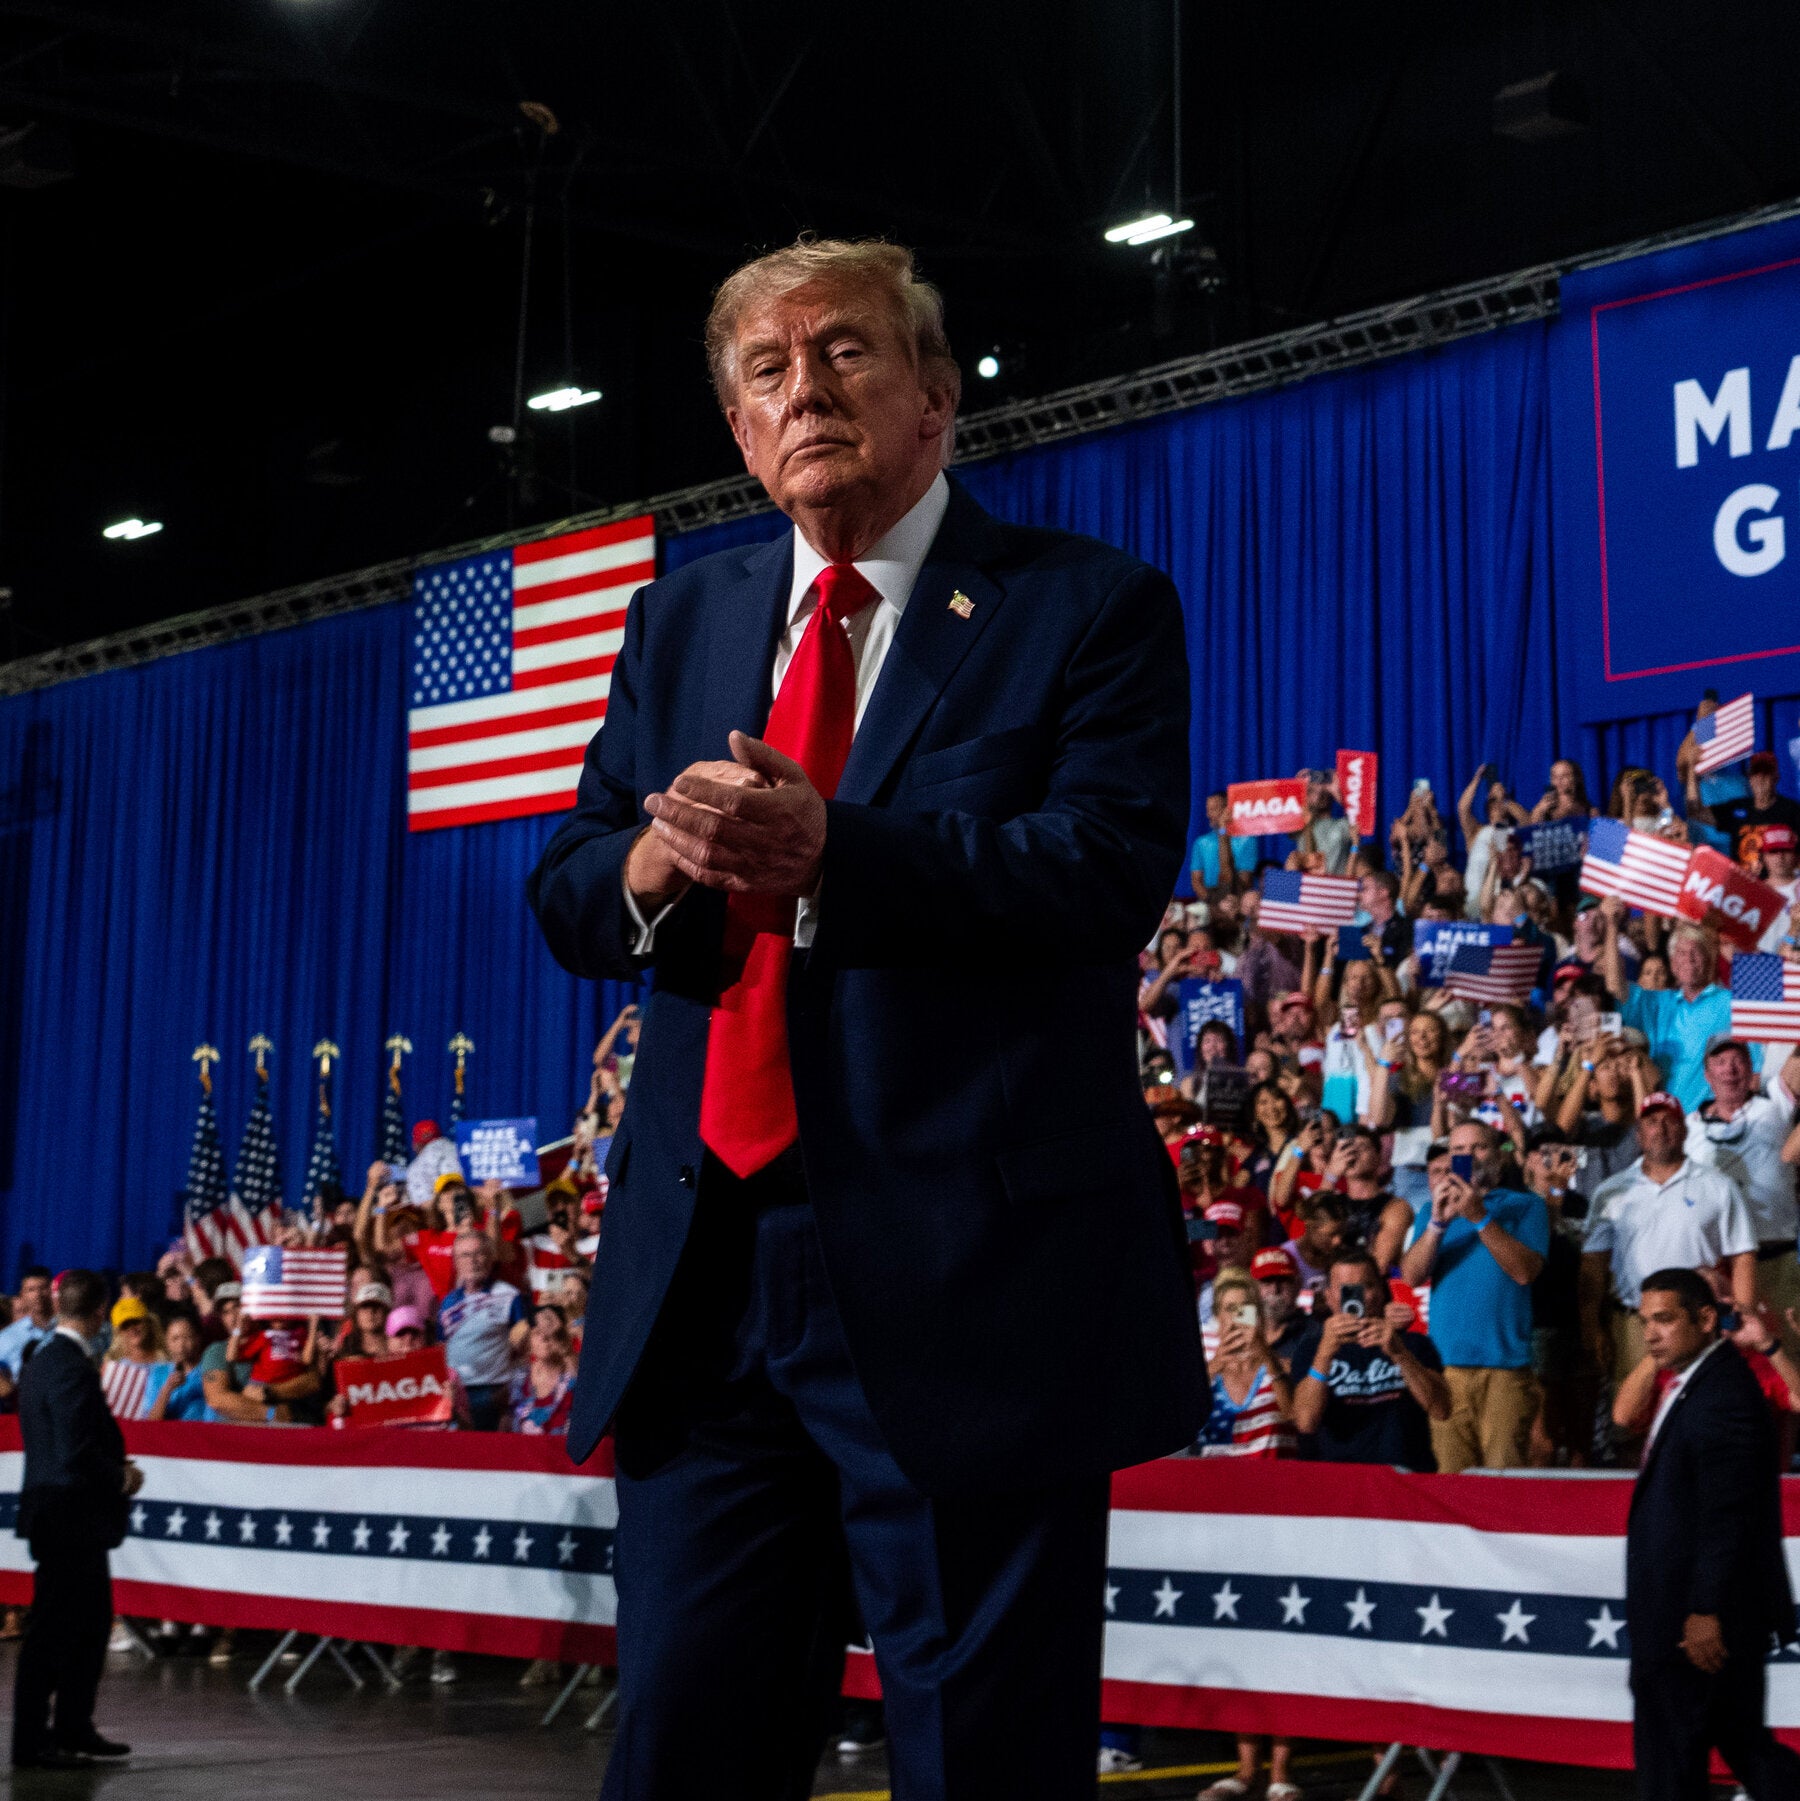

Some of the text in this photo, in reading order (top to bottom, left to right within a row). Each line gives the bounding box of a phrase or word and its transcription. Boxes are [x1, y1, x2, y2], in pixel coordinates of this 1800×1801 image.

[1233, 796, 1303, 819] MAGA
[1683, 871, 1761, 932] MAGA
[1437, 930, 1490, 946] MAKE
[471, 1127, 517, 1142] MAKE
[348, 1374, 442, 1406] MAGA
